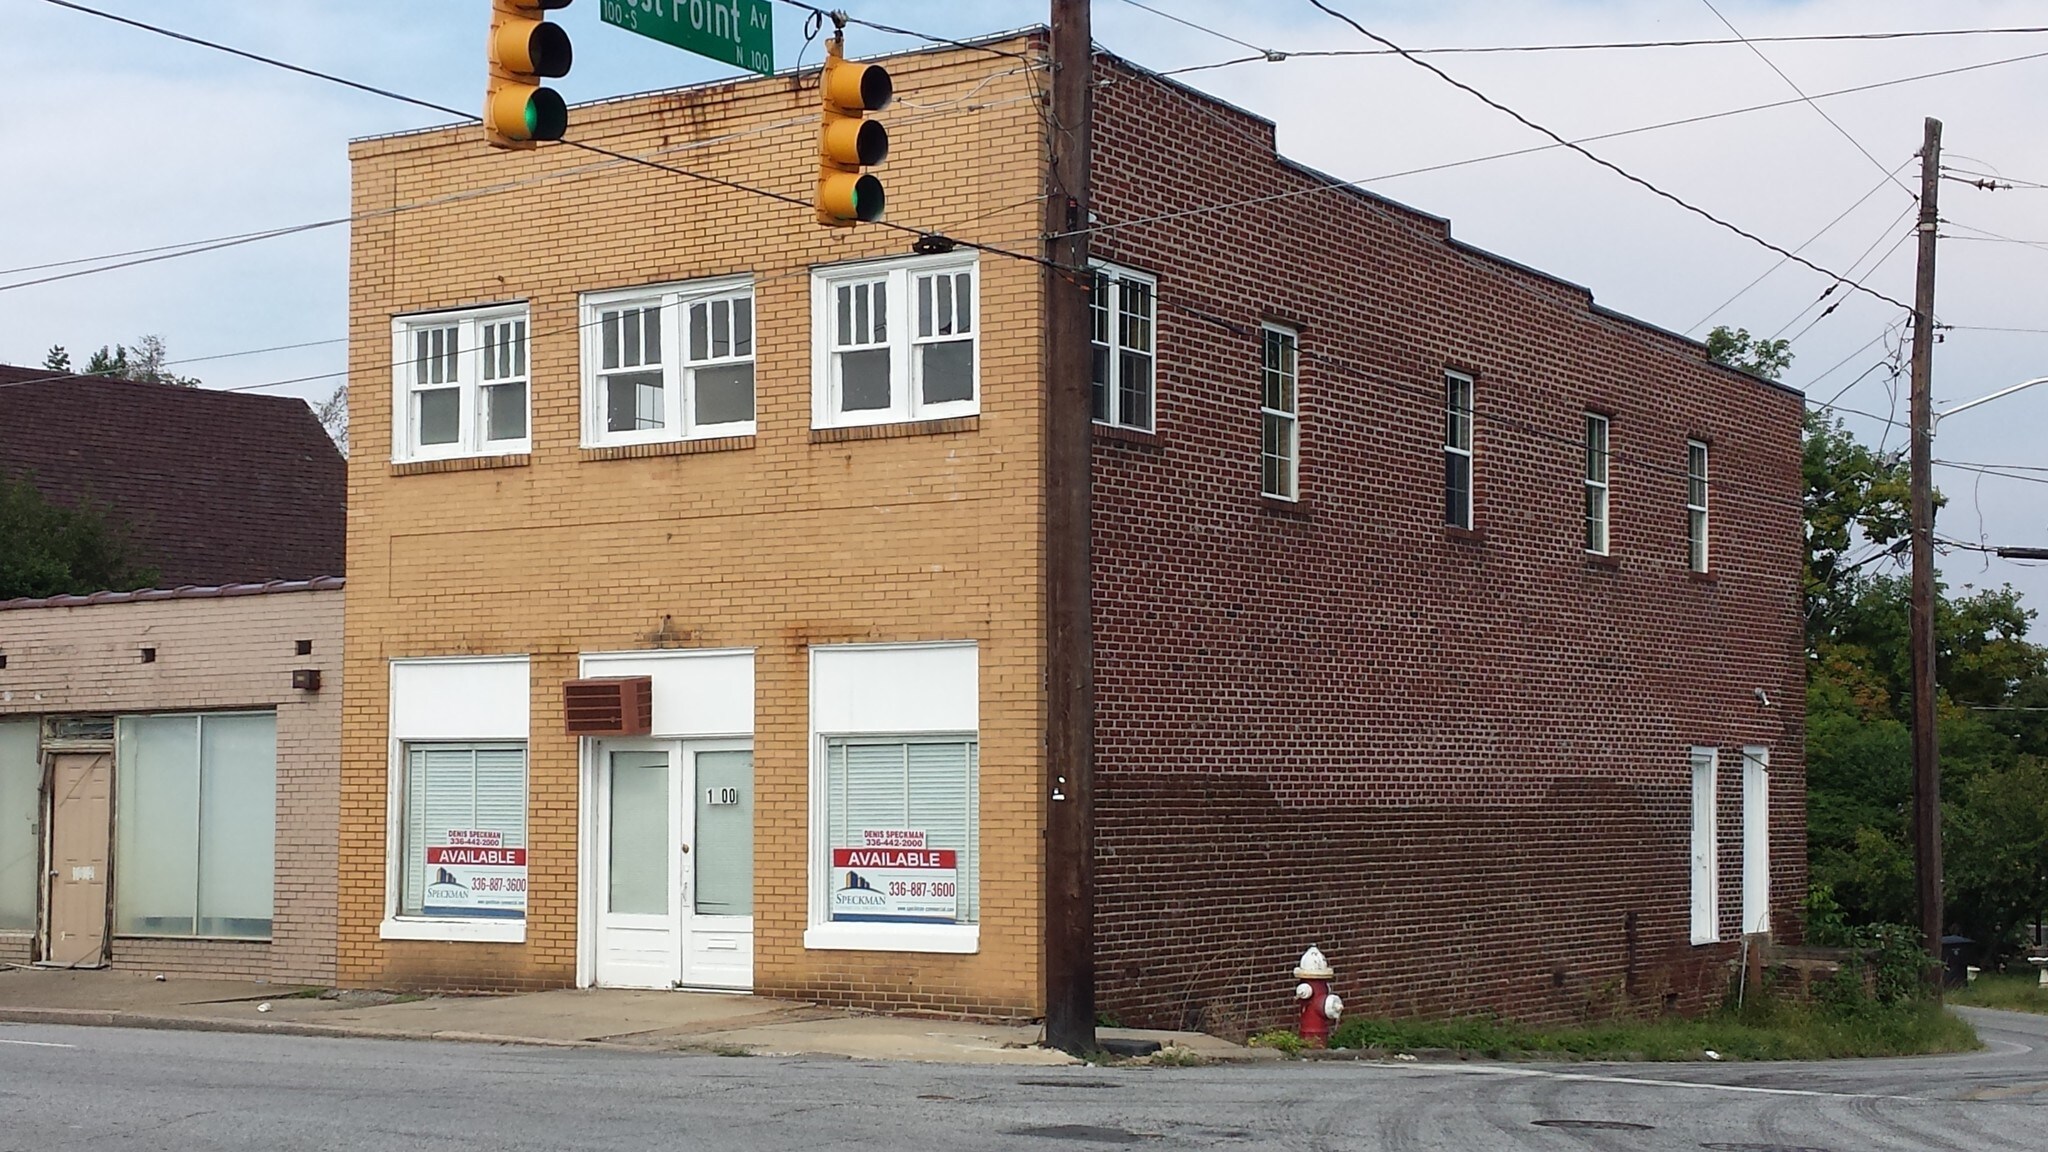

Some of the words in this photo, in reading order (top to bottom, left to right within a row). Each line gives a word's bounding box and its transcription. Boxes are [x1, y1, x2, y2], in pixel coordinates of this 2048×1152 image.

[673, 0, 741, 43] Point
[750, 4, 767, 29] Av
[736, 45, 743, 64] N
[751, 50, 769, 72] 100
[448, 830, 467, 838] DENIS
[469, 831, 501, 839] SPECKMAN
[864, 830, 884, 838] DENIS
[886, 830, 924, 838] SPECKMAN
[866, 838, 923, 847] 336-442-2000
[439, 850, 516, 864] AVAILABLE
[848, 852, 941, 867] AVAILABLE
[471, 877, 526, 892] 336-887-3600
[888, 882, 955, 897] 336-887-3600
[835, 894, 886, 905] SPECKMAN
